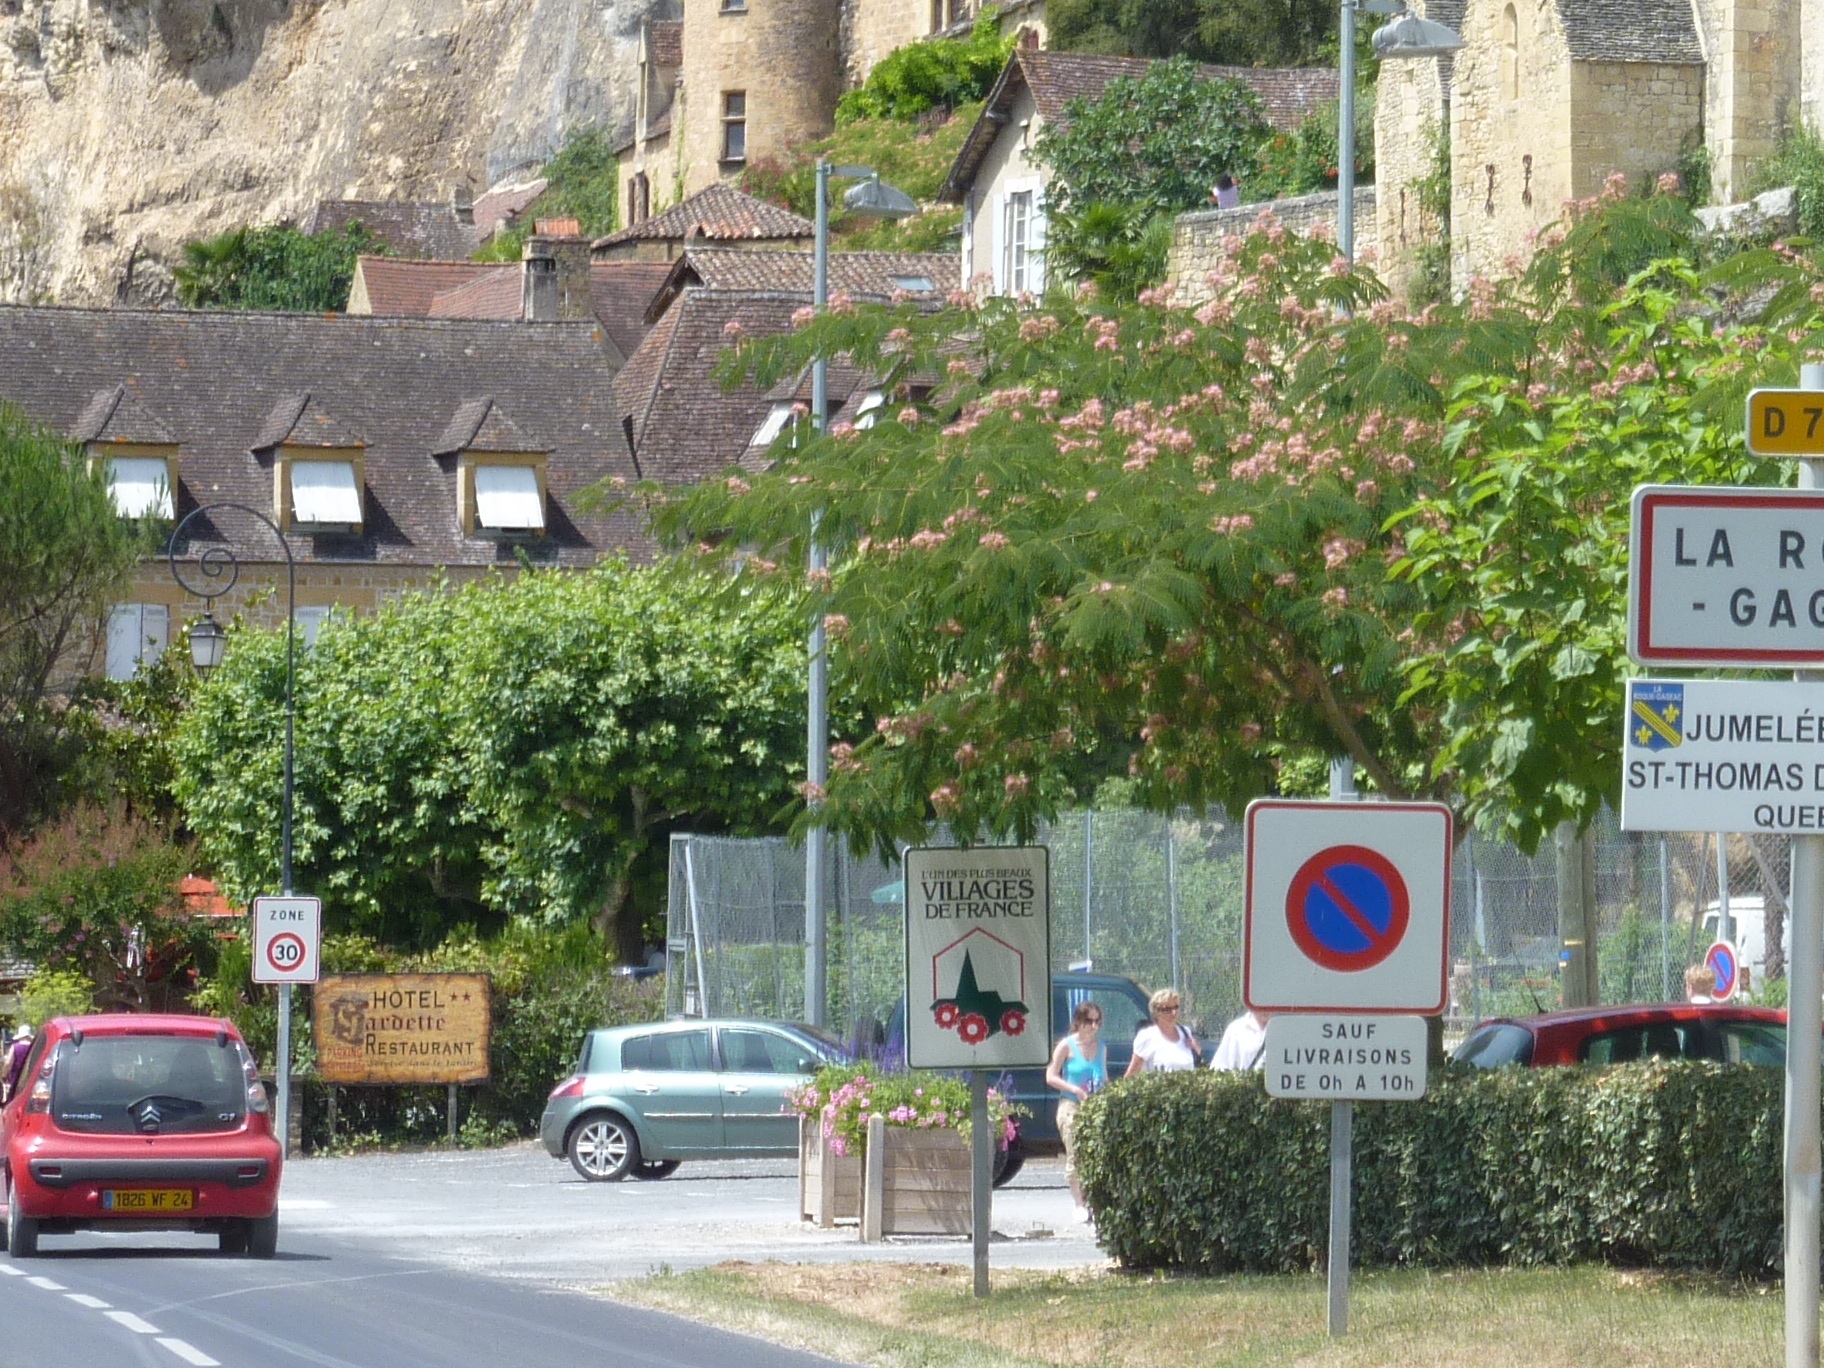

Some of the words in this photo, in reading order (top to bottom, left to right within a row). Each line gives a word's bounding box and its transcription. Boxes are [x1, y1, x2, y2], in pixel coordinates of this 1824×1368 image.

[1764, 408, 1786, 438] D
[1675, 528, 1735, 568] LA
[1628, 762, 1803, 791] ST-THOMAS
[946, 870, 968, 879] DES
[969, 869, 995, 879] PLUS
[996, 868, 1032, 879] BEAUX
[921, 879, 1035, 902] VILLAGES
[269, 910, 305, 921] ZONE
[925, 903, 952, 920] DE
[955, 901, 1034, 919] FRANCE
[275, 944, 298, 961] 30
[373, 990, 446, 1009] HOTEL
[1322, 1023, 1377, 1040] SAUF
[1284, 1048, 1411, 1065] LIVRAISONS
[1281, 1074, 1306, 1091] DE
[1356, 1074, 1366, 1090] A
[1380, 1075, 1414, 1092] 10h
[116, 1192, 146, 1207] 1826
[152, 1192, 167, 1207] WF
[173, 1192, 189, 1207] 24
